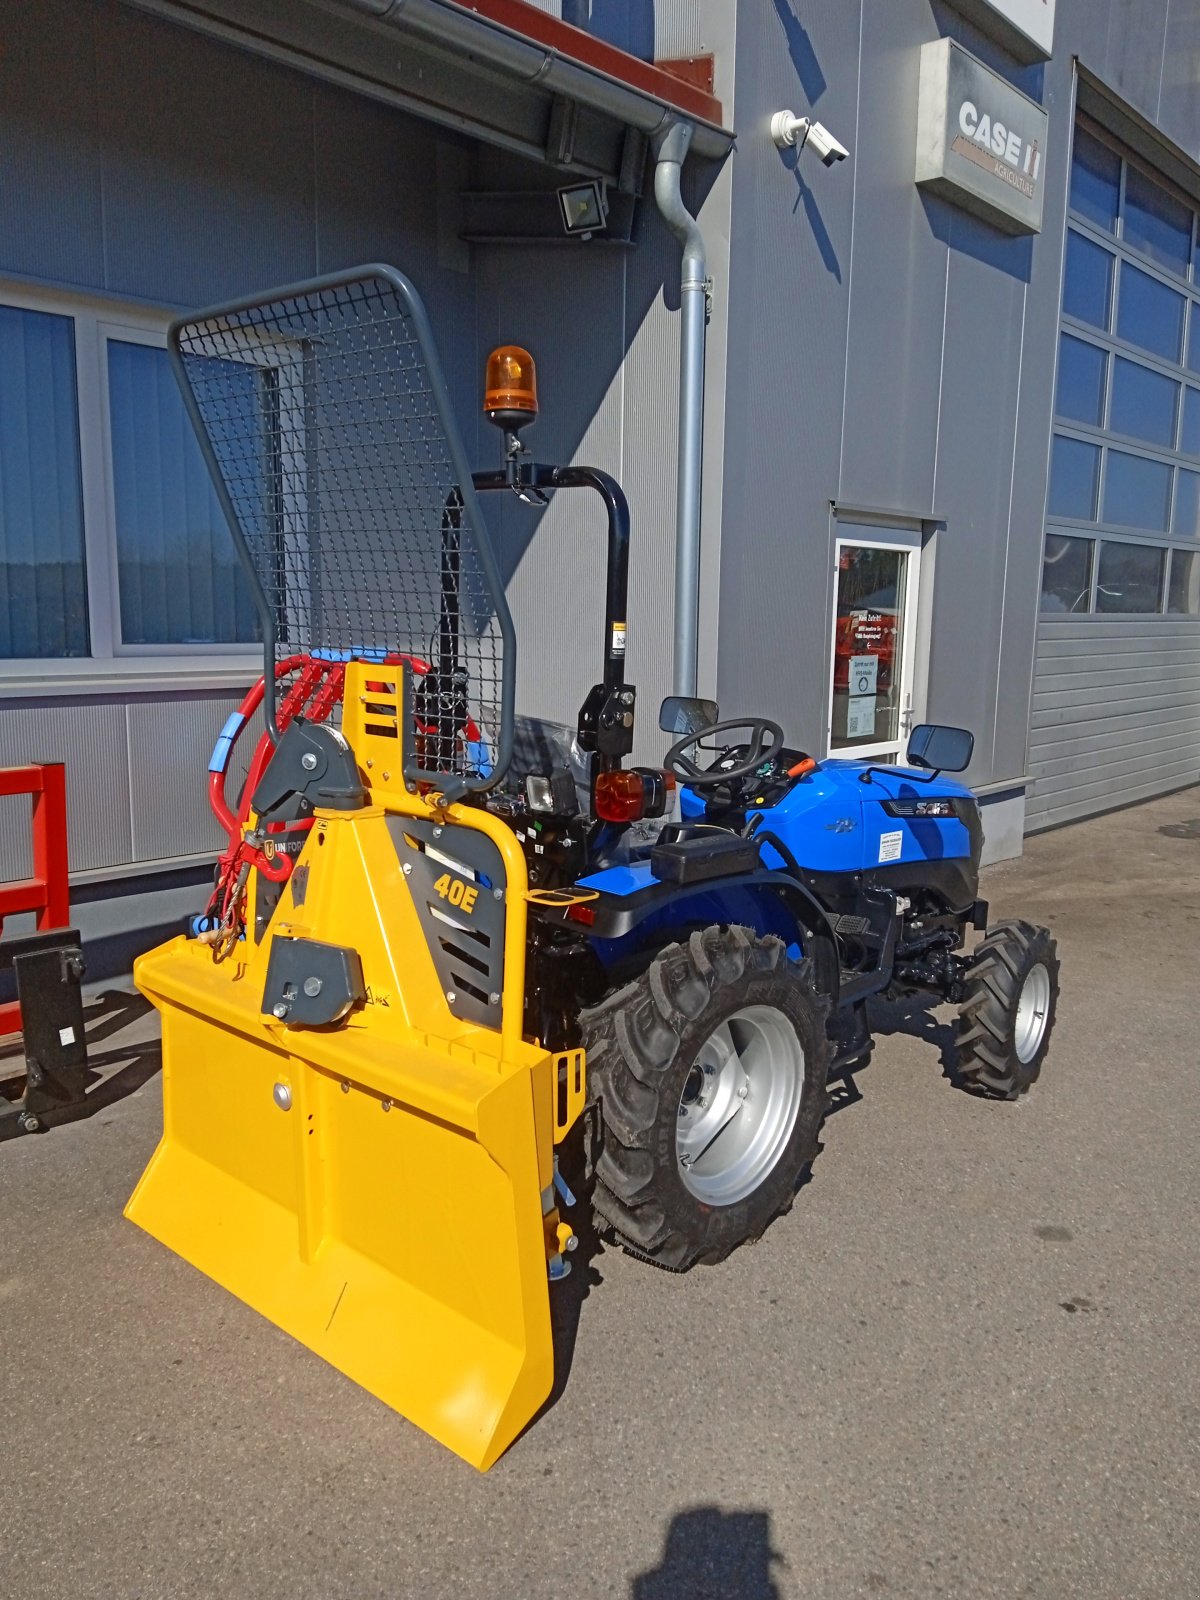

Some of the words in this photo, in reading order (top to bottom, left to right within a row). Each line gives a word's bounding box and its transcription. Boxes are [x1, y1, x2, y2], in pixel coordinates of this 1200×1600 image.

[959, 101, 1022, 166] CASE
[994, 162, 1034, 197] AGRICULTURE
[433, 873, 479, 914] 40E
